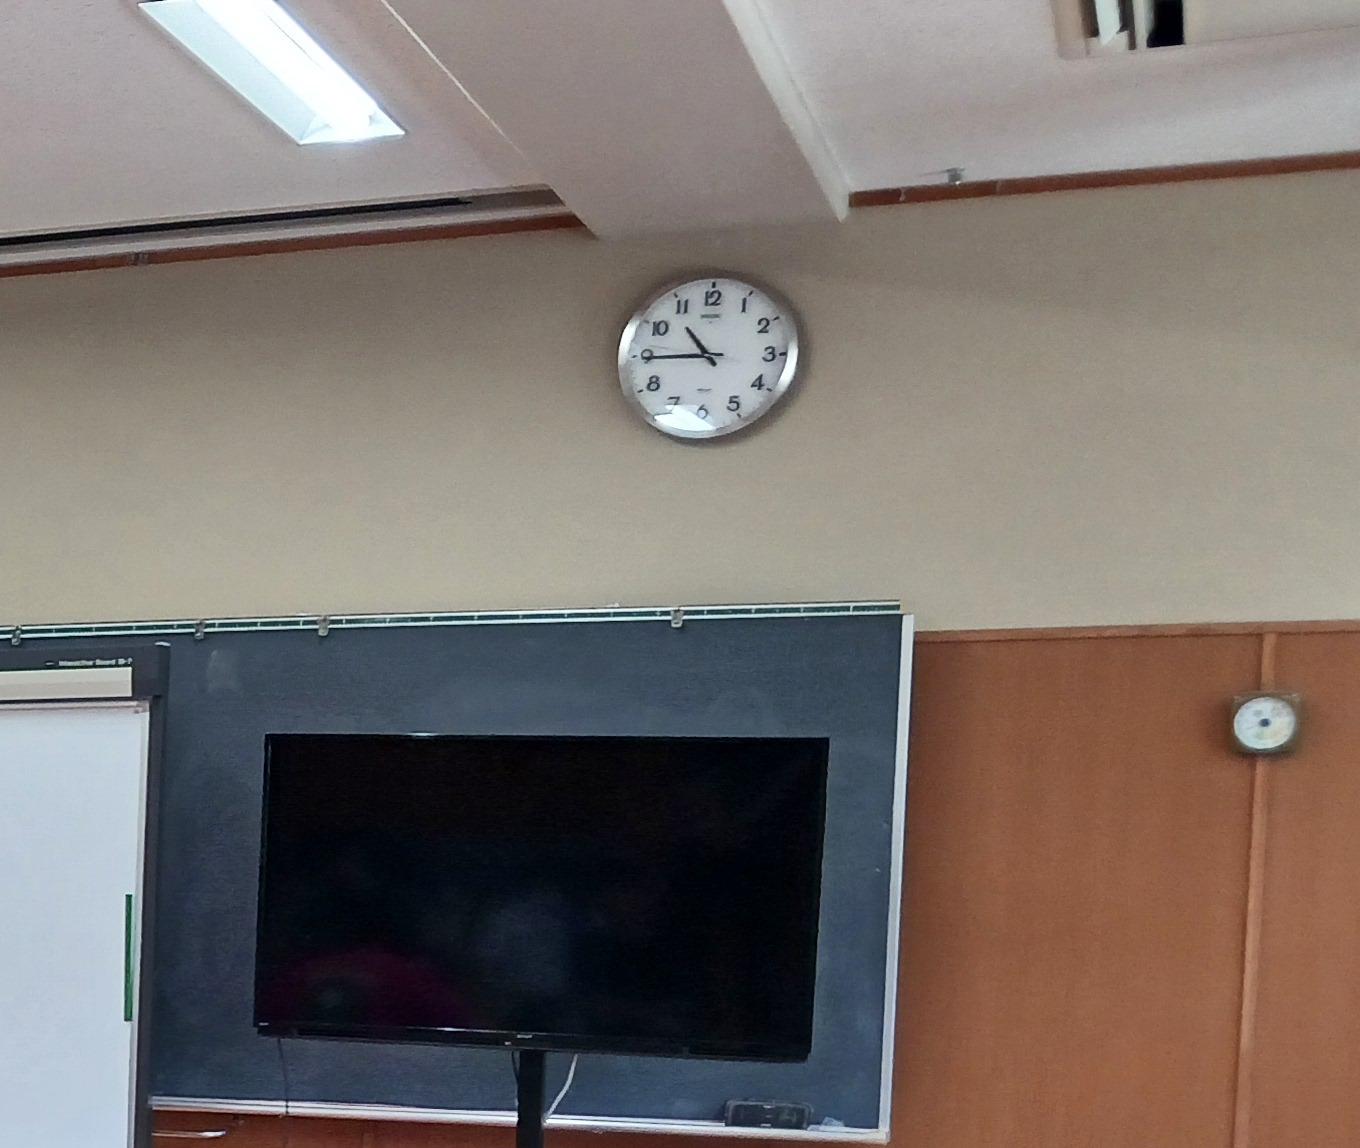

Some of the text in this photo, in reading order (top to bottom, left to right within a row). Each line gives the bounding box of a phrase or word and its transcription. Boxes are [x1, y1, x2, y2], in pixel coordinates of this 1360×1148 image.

[704, 289, 722, 307] 12
[740, 297, 748, 313] 1
[675, 298, 689, 315] 11
[651, 320, 669, 336] 10
[757, 317, 771, 334] 2
[640, 348, 654, 364] 9
[761, 346, 776, 362] 3
[646, 375, 661, 391] 8
[750, 373, 764, 391] 4
[726, 395, 741, 412] 5
[696, 404, 709, 420] 6
